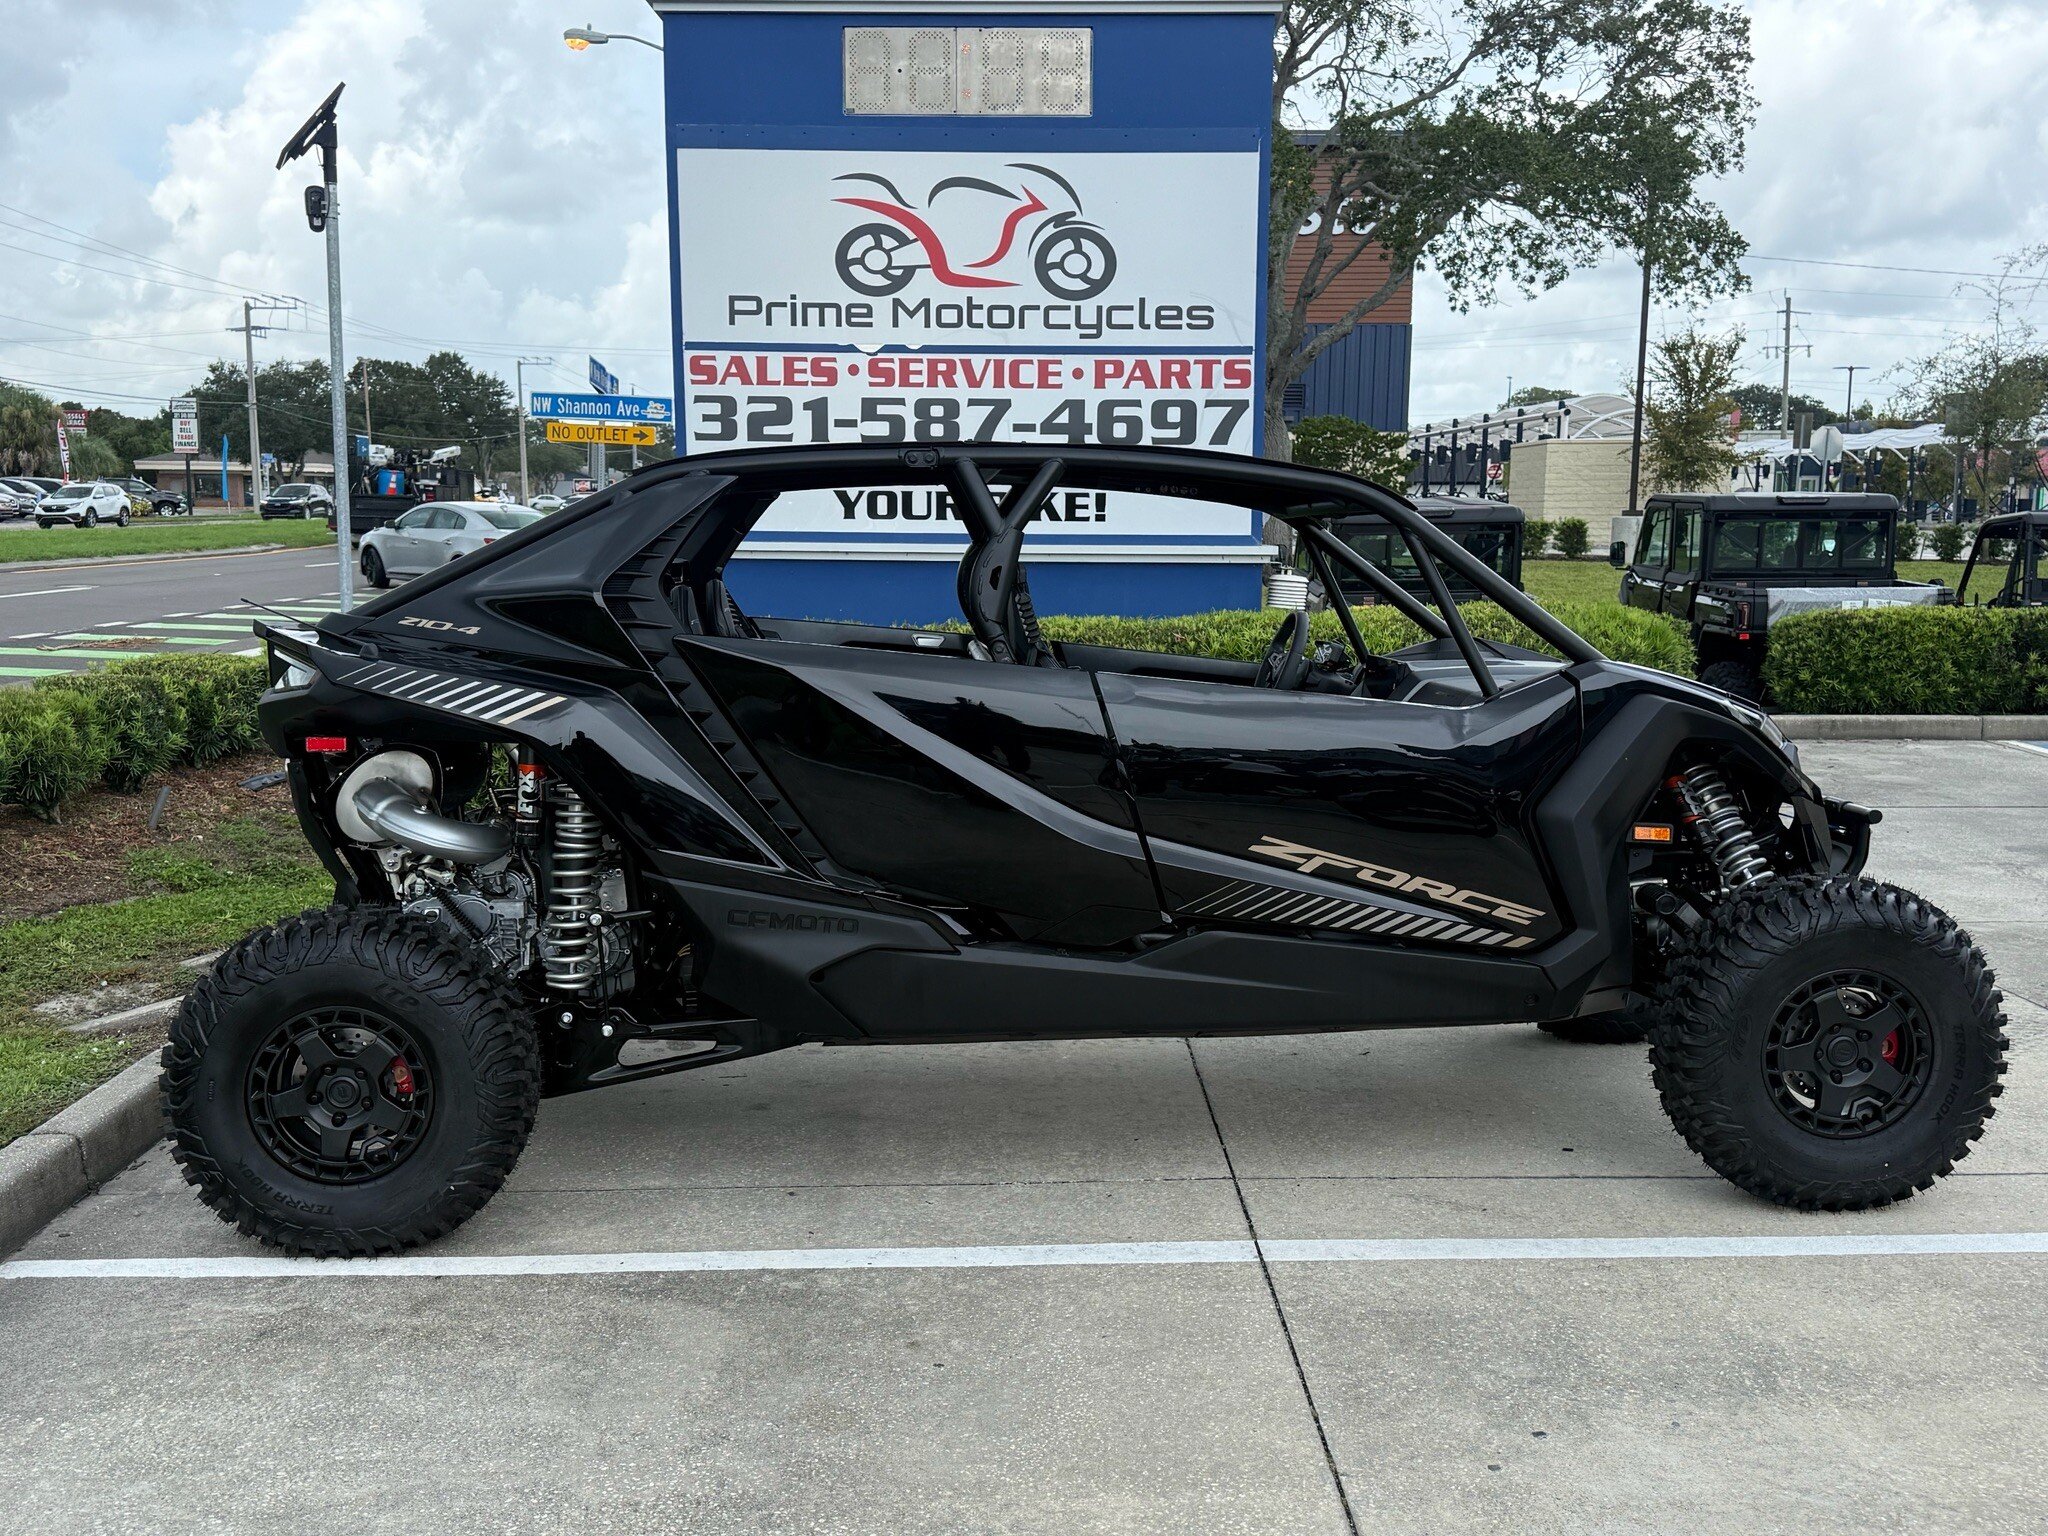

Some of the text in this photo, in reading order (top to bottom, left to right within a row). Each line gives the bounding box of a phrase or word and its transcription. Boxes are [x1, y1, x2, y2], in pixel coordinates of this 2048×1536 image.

[728, 294, 1215, 339] Prime Motorcycles
[689, 355, 1251, 389] SALES SERVICE PARTS
[533, 396, 552, 413] NW
[557, 397, 611, 416] Shannon
[616, 400, 640, 417] Ave
[693, 395, 1250, 445] 321-587-4697
[552, 426, 628, 442] NO OUTLET
[833, 490, 963, 521] YOUR
[1247, 834, 1546, 926] ZFORCE
[727, 908, 860, 935] CFMOTO
[236, 1155, 336, 1216] TERRA HOOK
